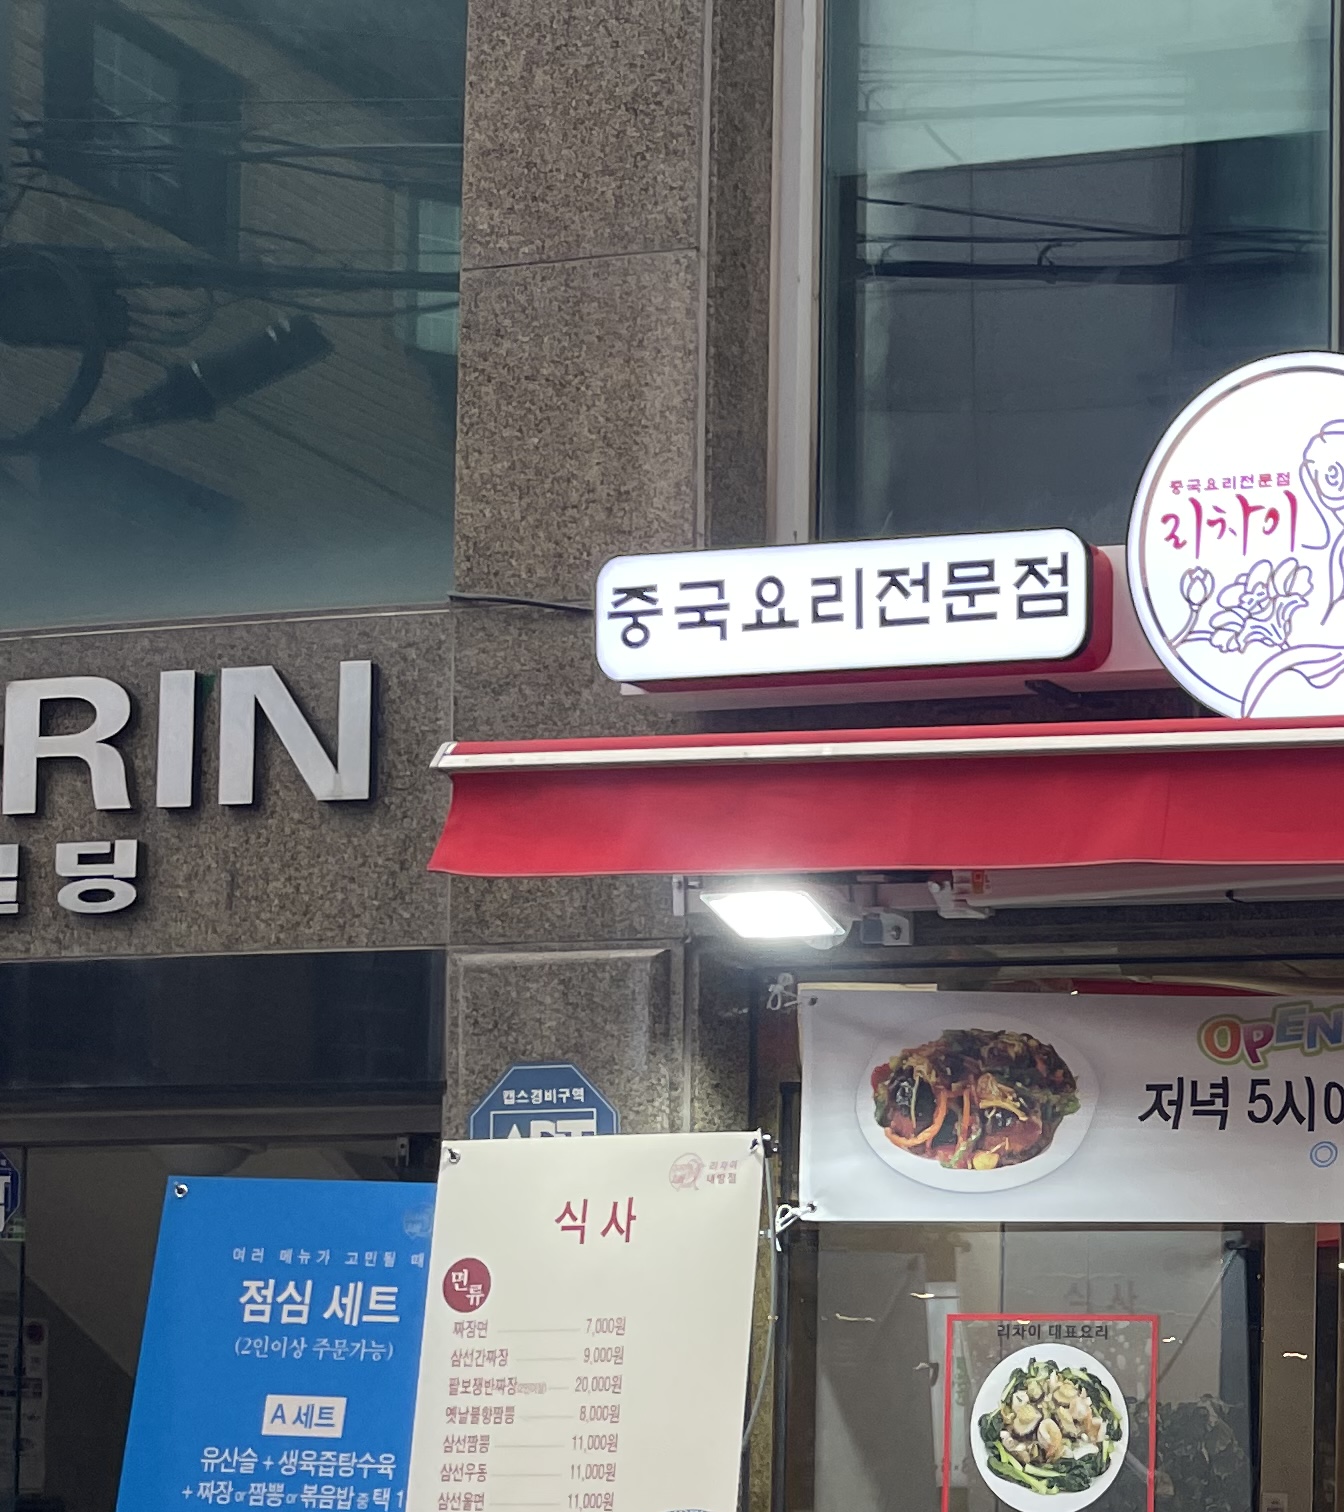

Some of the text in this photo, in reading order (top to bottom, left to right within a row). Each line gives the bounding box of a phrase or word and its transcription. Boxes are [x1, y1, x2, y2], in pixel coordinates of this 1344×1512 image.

[1169, 472, 1291, 493] 중국요리전문점
[1160, 493, 1299, 557] 리차이
[606, 550, 1071, 650] 중국요리전문점
[2, 660, 372, 815] RIN
[0, 839, 137, 914] 딩
[1138, 1076, 1231, 1131] 저녁
[232, 1247, 265, 1263] 여러
[279, 1248, 331, 1265] 메뉴가
[239, 1279, 400, 1326] 점심 세트
[453, 1317, 626, 1338] 짜장면 7,000원
[997, 1324, 1109, 1340] 리차이 대표요리
[235, 1337, 394, 1362] (2인이상 주문가능)
[450, 1346, 624, 1367] 삼선간짜장 9,000원
[575, 1375, 623, 1394] 20,000원
[270, 1404, 336, 1429] A 세트
[579, 1404, 621, 1424] 8,000원
[571, 1433, 619, 1453] 11,000원
[201, 1447, 397, 1480] 유산슬 생육즙탕수육
[440, 1463, 617, 1483] 삼선우동 11,000원
[197, 1480, 355, 1511] 짜장 짬뽕 볶음밥
[567, 1492, 614, 1512] 11,000원
